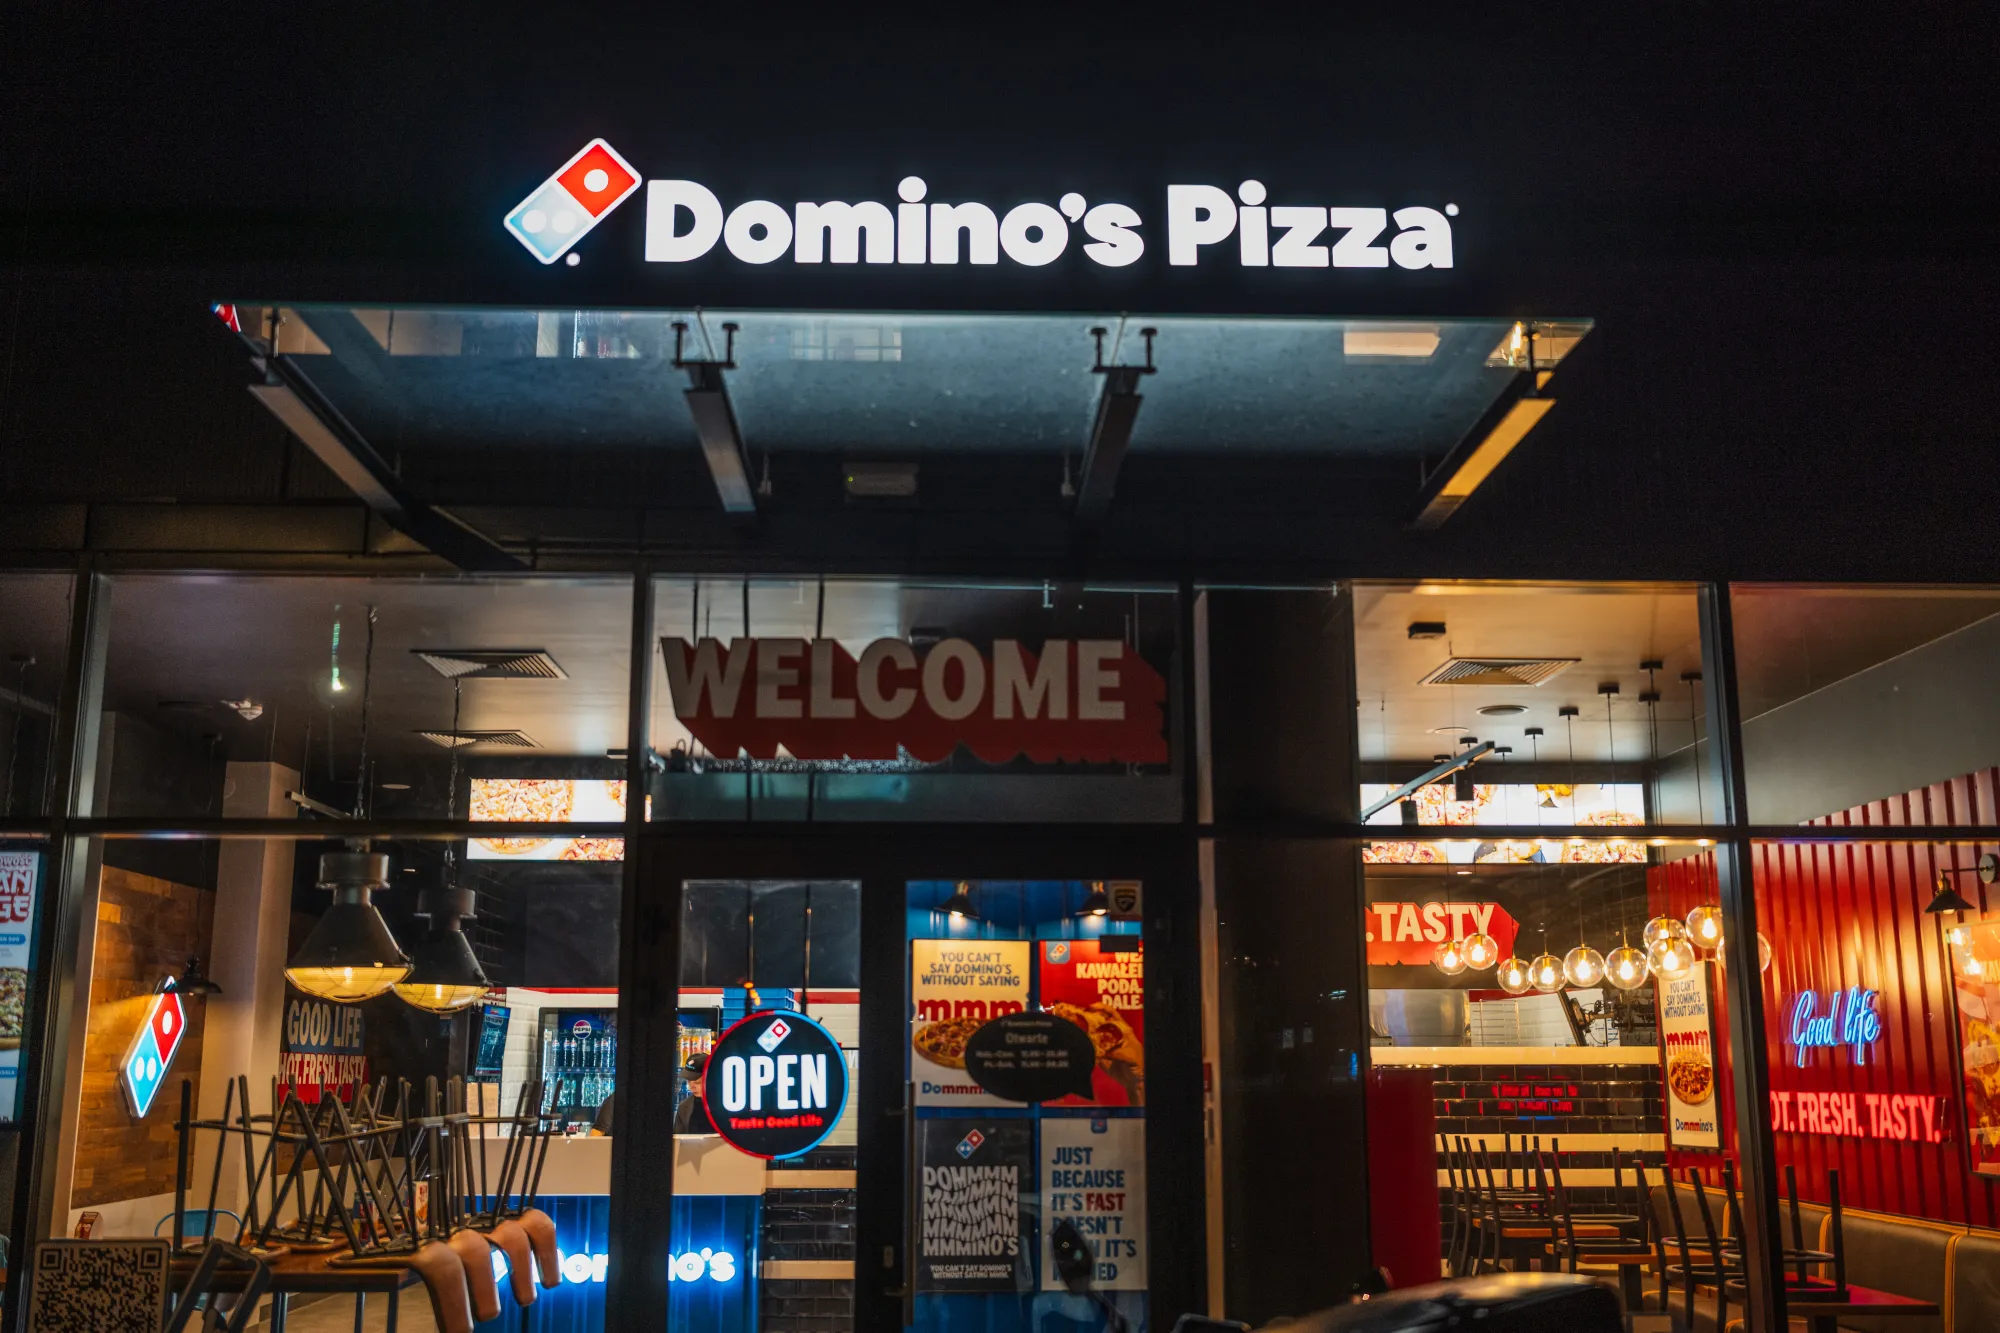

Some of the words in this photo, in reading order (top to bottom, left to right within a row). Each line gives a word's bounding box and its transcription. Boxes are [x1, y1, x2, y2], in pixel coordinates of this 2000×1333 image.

[645, 176, 1144, 267] Domino's
[1167, 180, 1455, 269] Pizza
[661, 637, 1126, 720] WELCOME
[941, 952, 964, 962] YOU
[967, 952, 1002, 962] CAN'T
[930, 963, 951, 974] SAY
[955, 963, 1012, 975] DOMINO'S
[921, 974, 976, 985] WITHOUT
[979, 975, 1020, 987] SAYING
[1669, 982, 1680, 993] YOU
[1666, 995, 1676, 1006] SAY
[919, 999, 1023, 1022] mmm
[1664, 1005, 1687, 1018] WITHOUT
[1688, 1003, 1706, 1016] SAYING
[287, 1000, 332, 1046] GOOD
[333, 1004, 363, 1048] LIFE
[1793, 990, 1839, 1068] Good
[1844, 984, 1879, 1065] life
[1666, 1030, 1710, 1055] mmm
[722, 1053, 828, 1113] OPEN
[729, 1117, 765, 1129] Taste
[765, 1115, 799, 1128] Good
[801, 1113, 823, 1127] Life
[1797, 1091, 1864, 1138] FRESH.
[1865, 1093, 1941, 1144] TASTY.
[1052, 1147, 1093, 1165] JUST
[1052, 1170, 1125, 1188] BECAUSE
[1052, 1193, 1083, 1211] IT'S
[1086, 1193, 1126, 1211] FAST
[1105, 1239, 1137, 1257] IT'S
